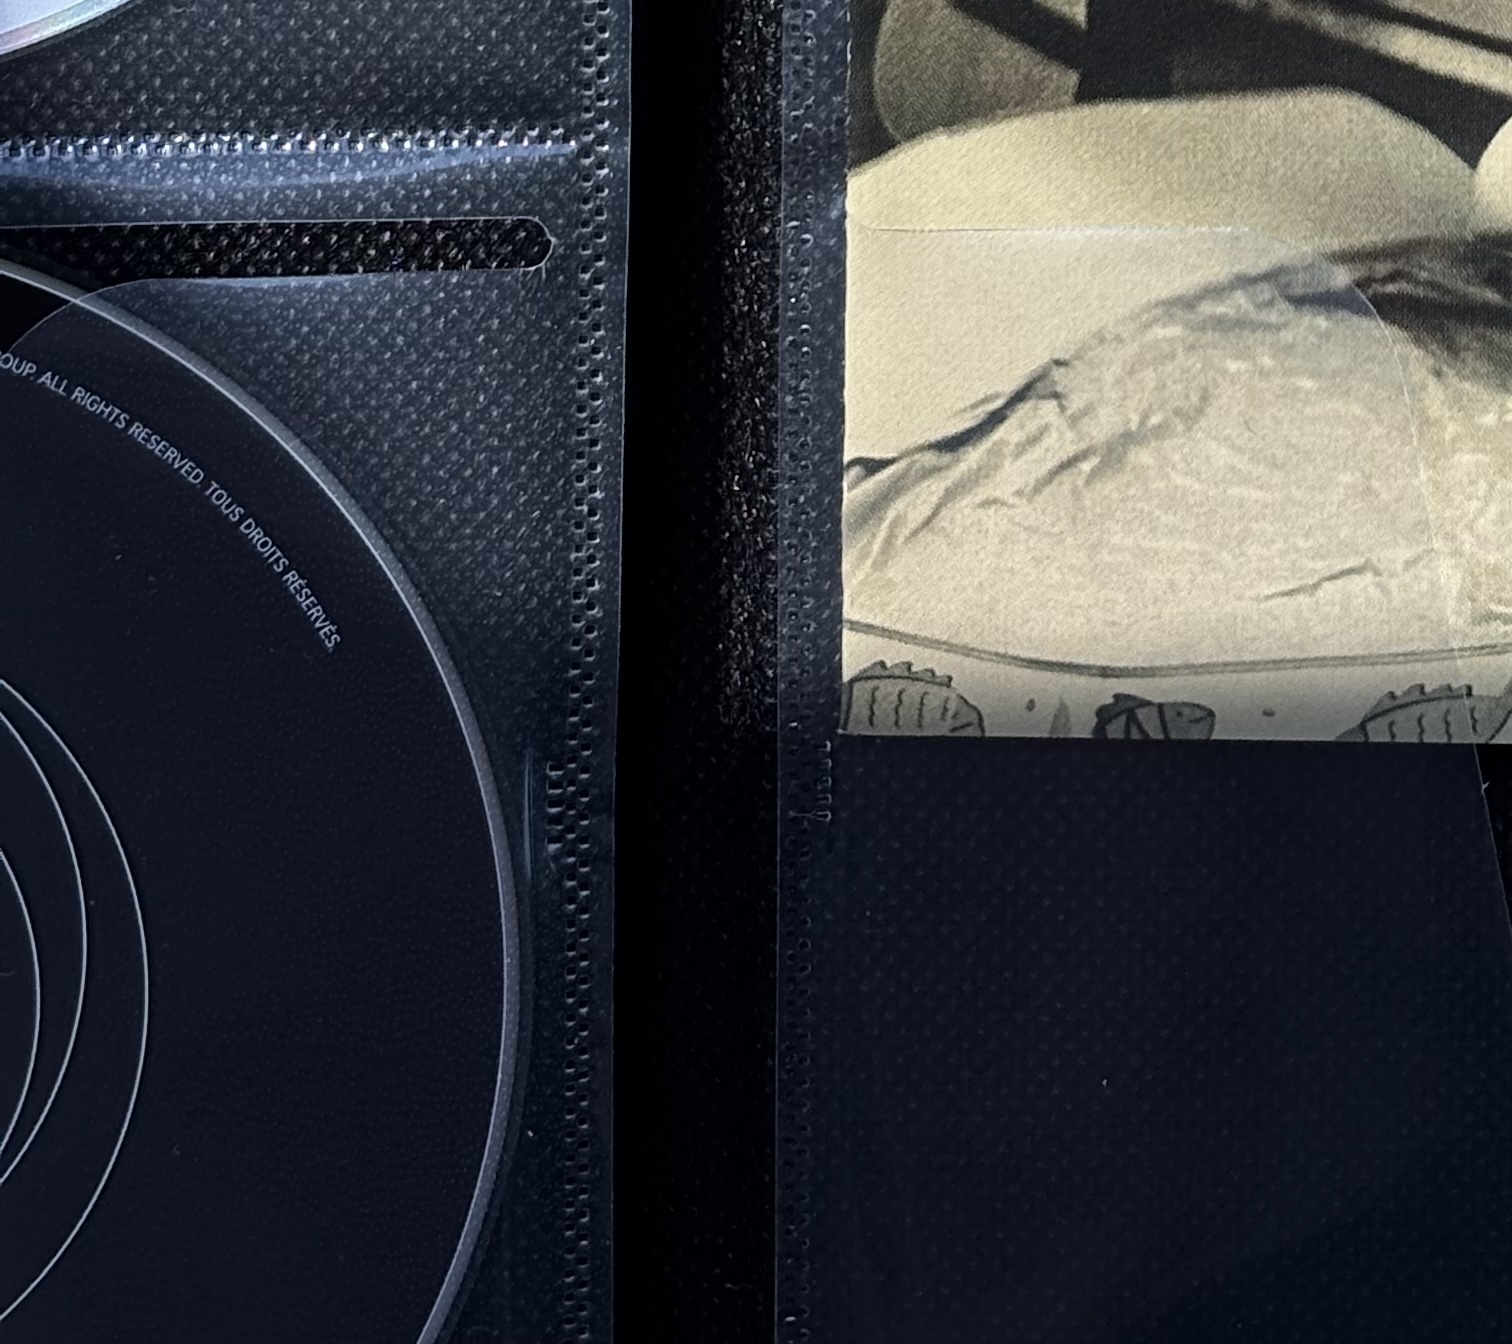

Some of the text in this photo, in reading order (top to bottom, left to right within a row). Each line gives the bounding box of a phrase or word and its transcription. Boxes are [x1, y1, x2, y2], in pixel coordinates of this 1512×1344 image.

[36, 370, 69, 397] ALL
[70, 386, 131, 430] RIGHTS
[204, 480, 246, 523] TOUS
[239, 517, 290, 573] DROITS
